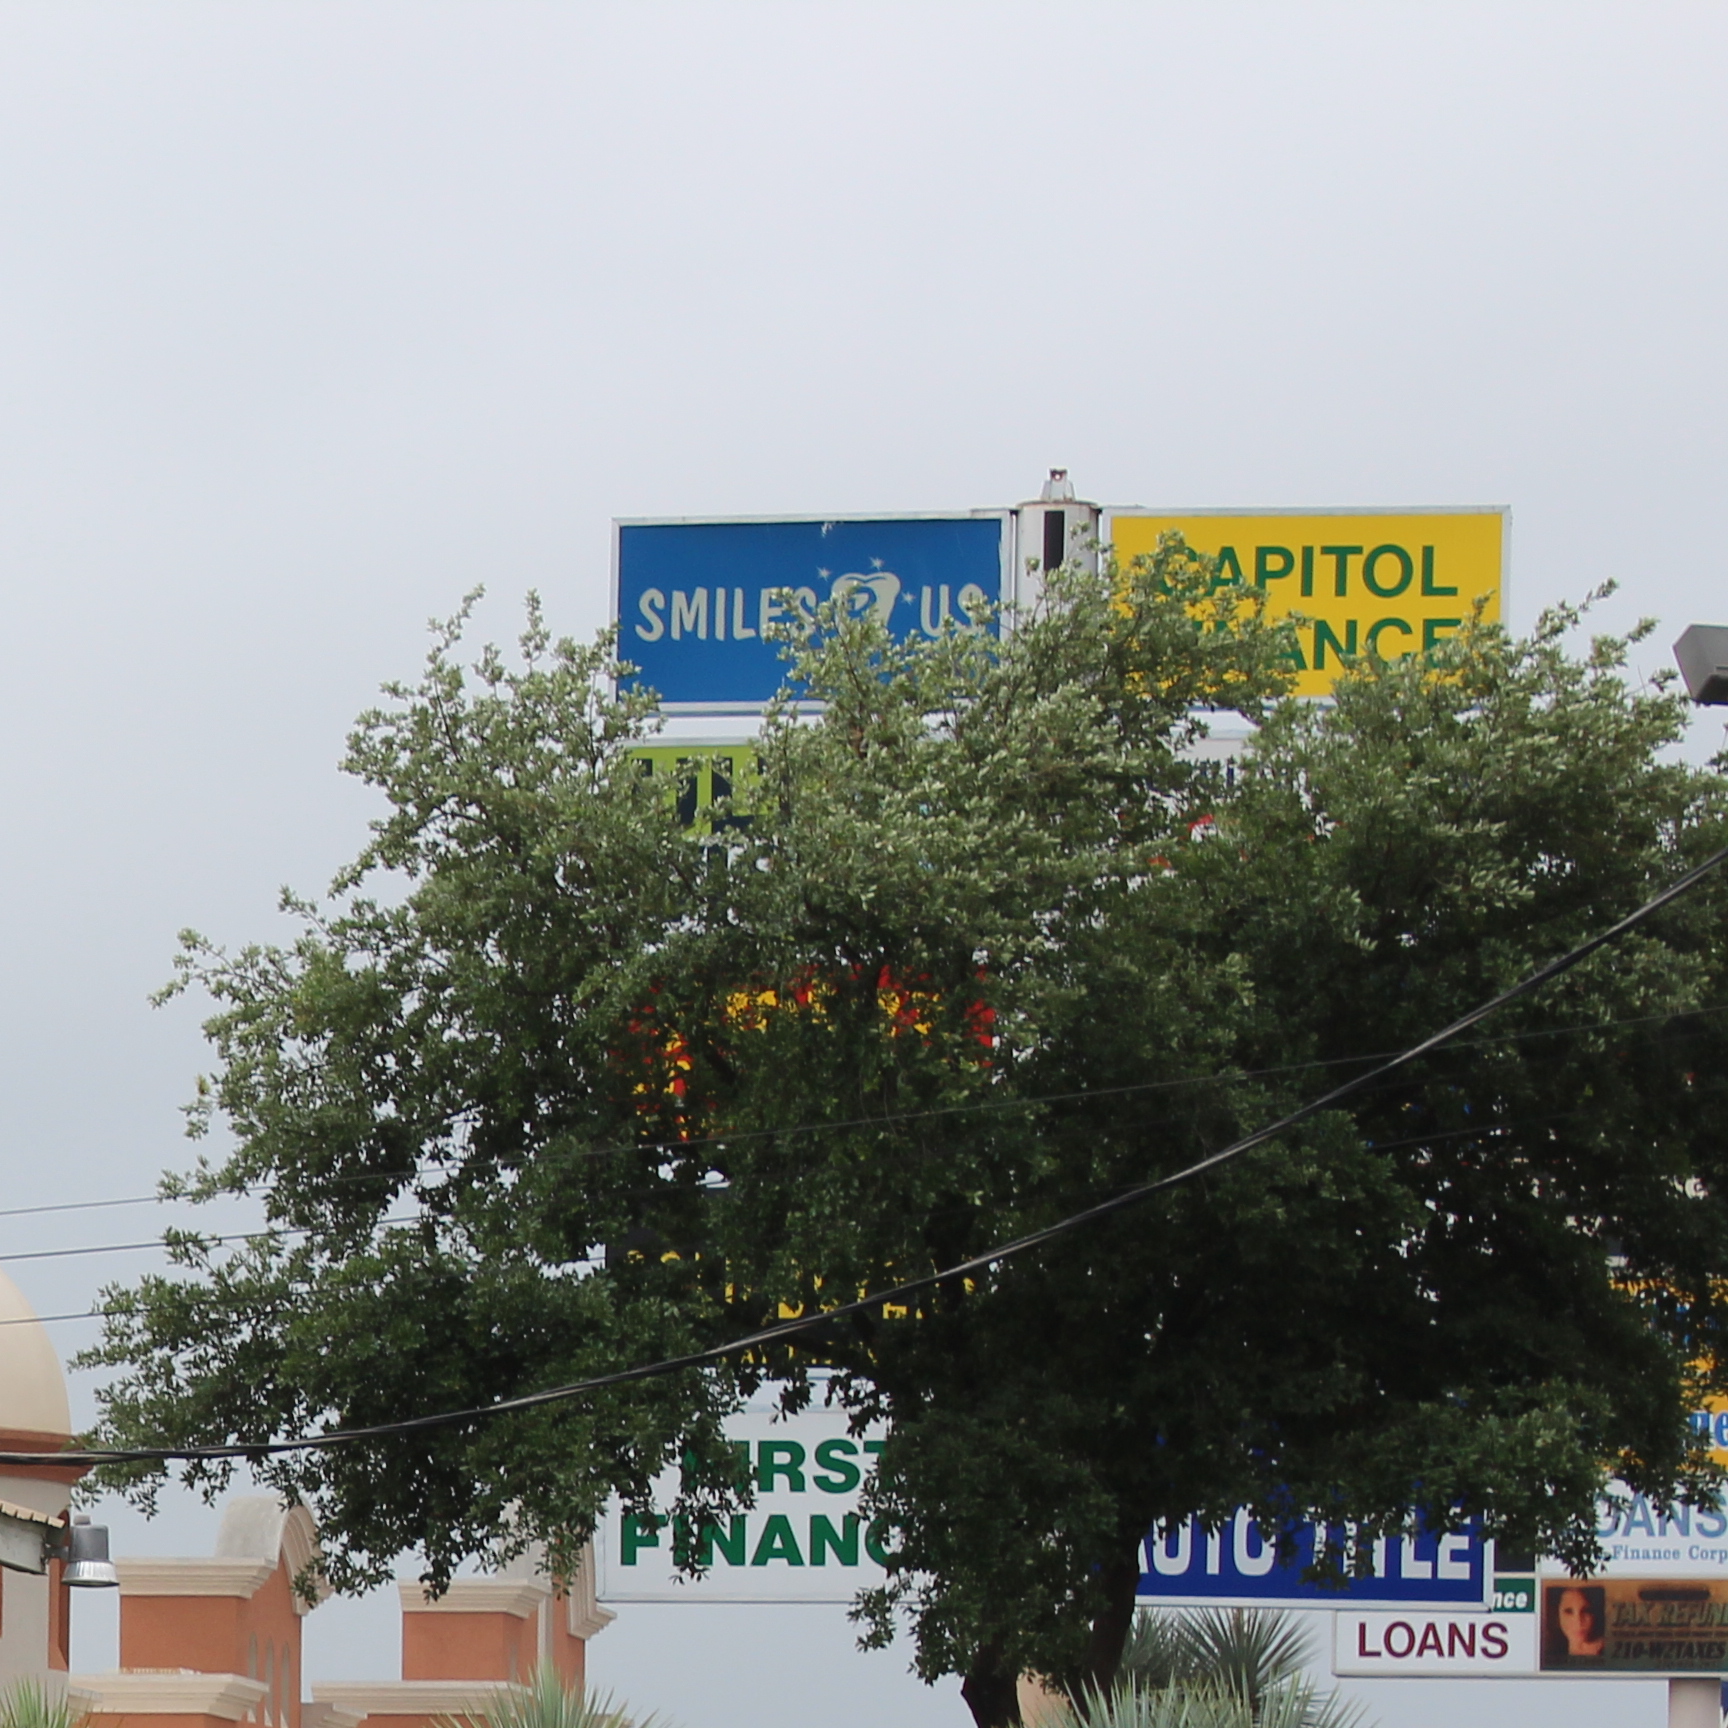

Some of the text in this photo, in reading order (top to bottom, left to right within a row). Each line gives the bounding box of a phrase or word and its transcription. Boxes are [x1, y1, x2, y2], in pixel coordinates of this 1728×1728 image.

[1158, 543, 1459, 598] CAPITOL
[635, 585, 818, 642] SMILES
[920, 582, 986, 638] US
[1189, 617, 1463, 671] ANCE
[1594, 1490, 1728, 1539] ANS
[620, 1513, 907, 1568] FINANC
[1612, 1544, 1681, 1561] Finance
[1357, 1620, 1510, 1660] LOANS
[1658, 1602, 1728, 1628] REFUN
